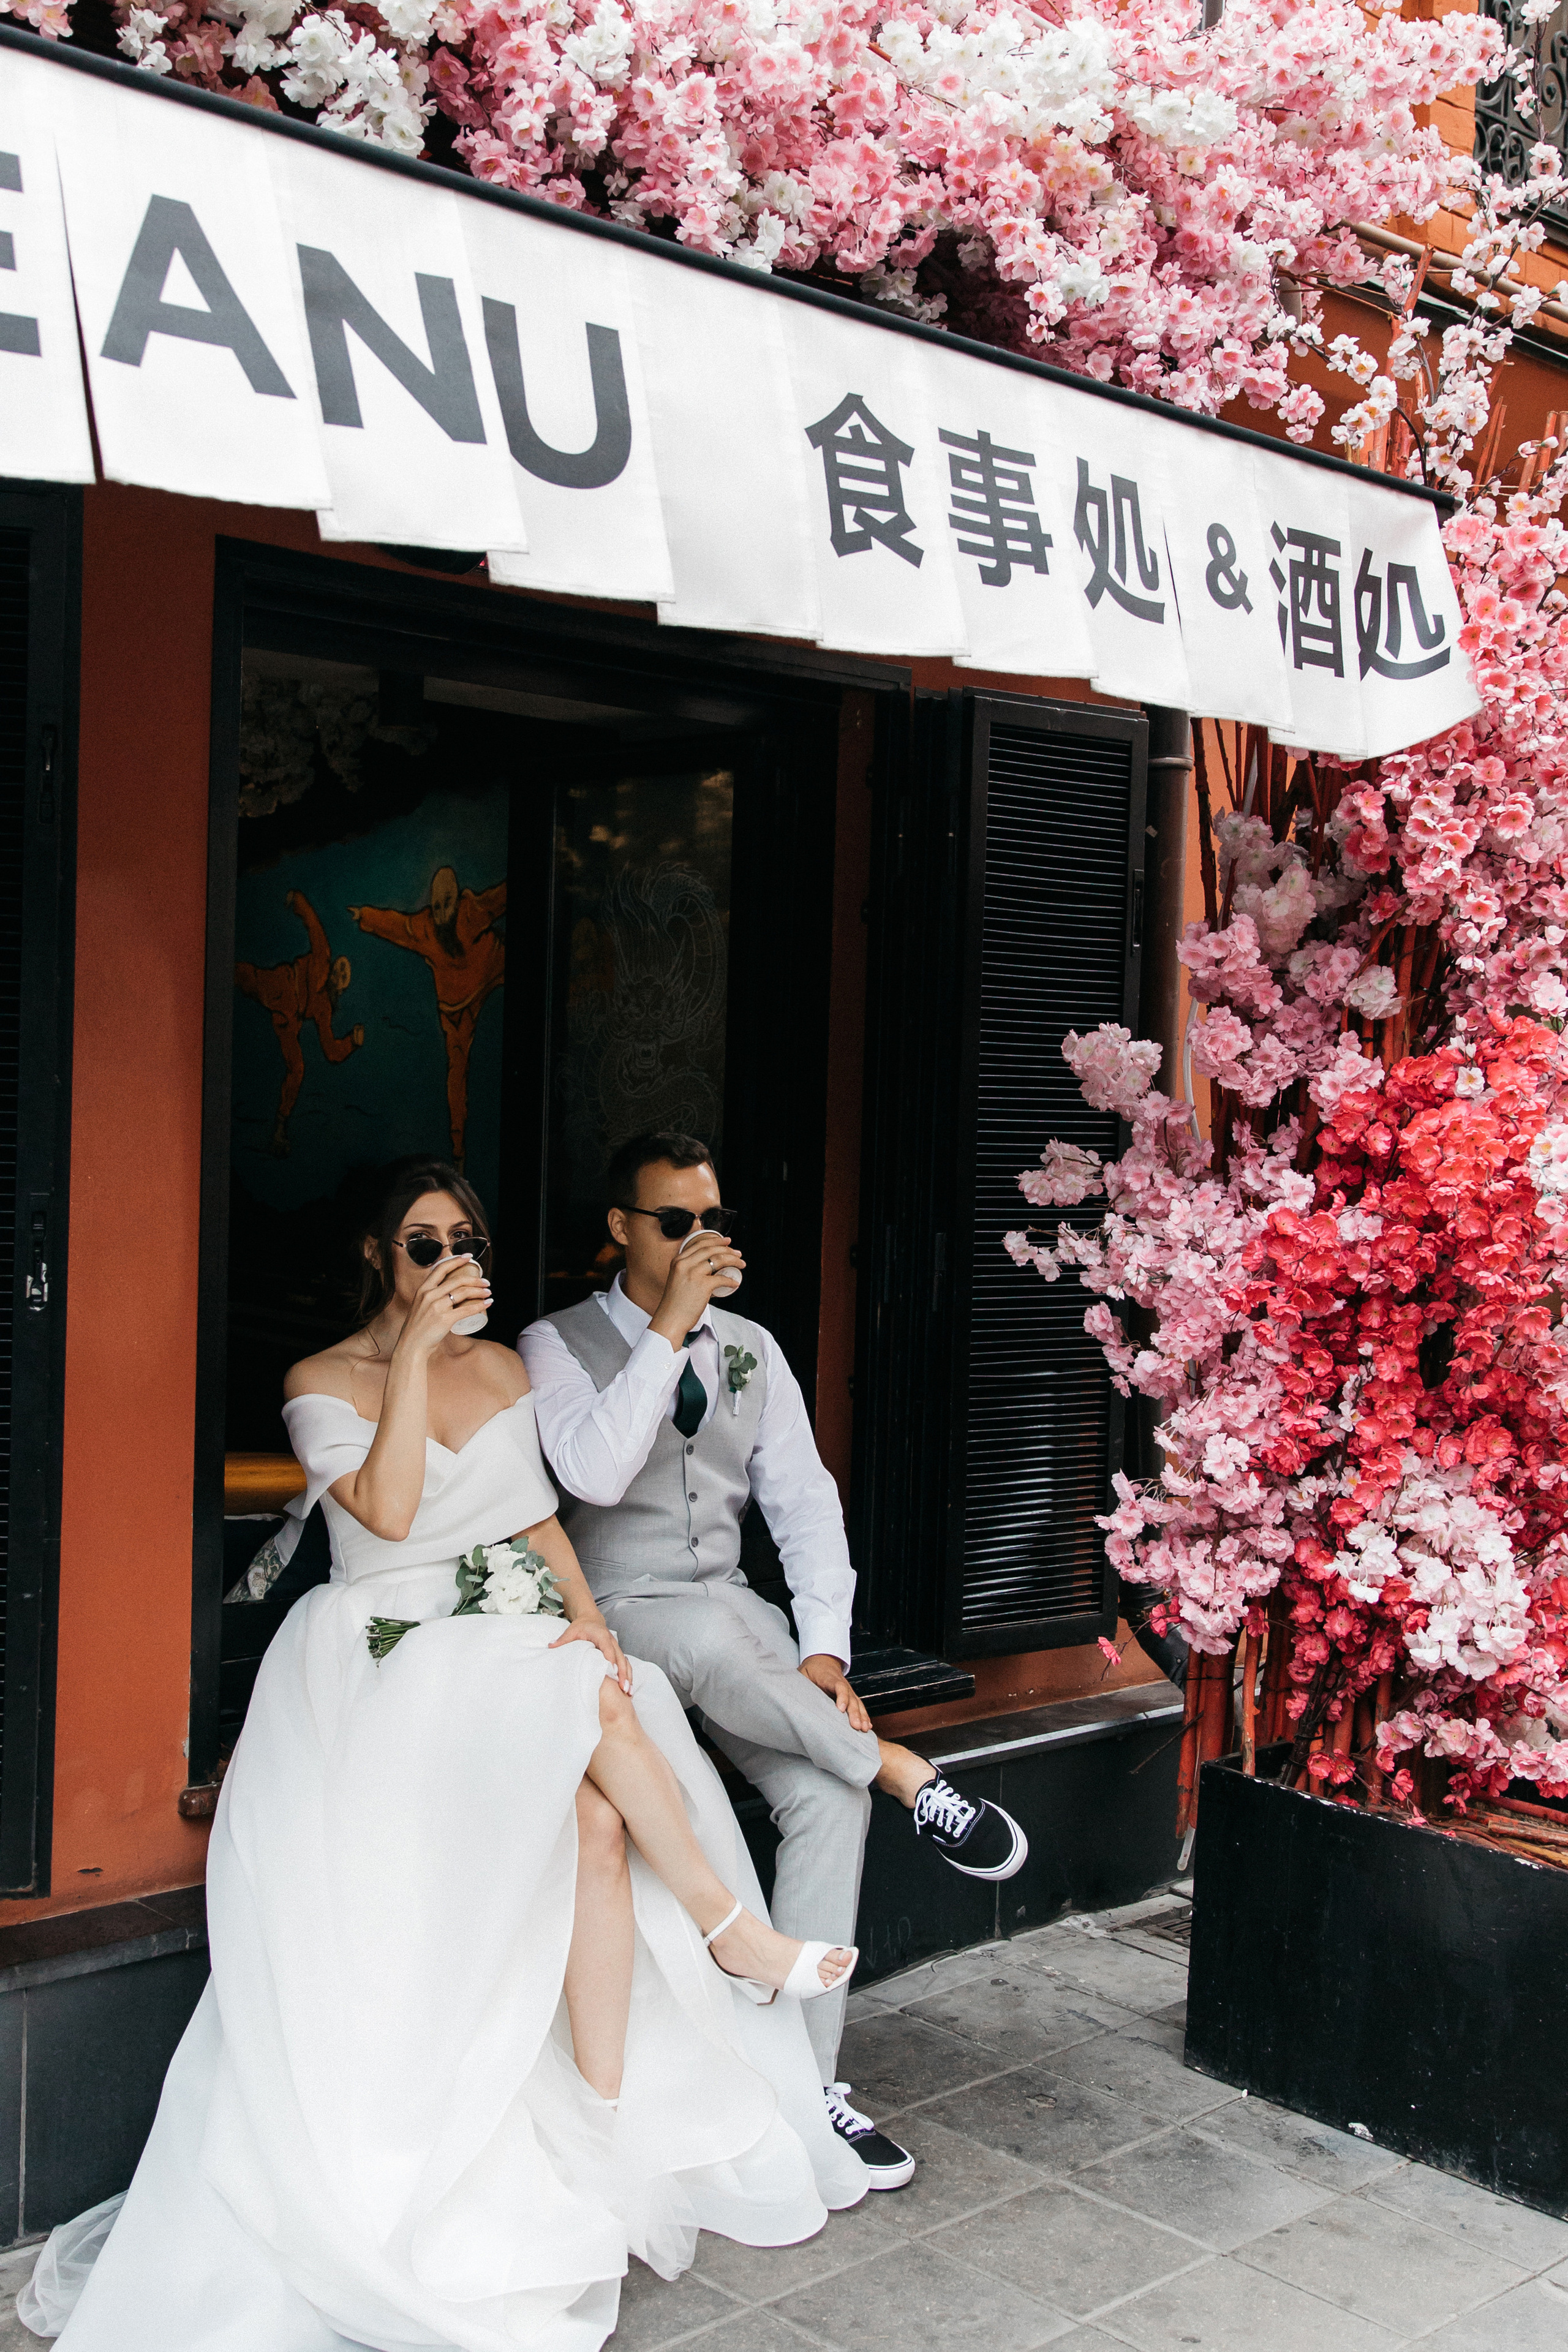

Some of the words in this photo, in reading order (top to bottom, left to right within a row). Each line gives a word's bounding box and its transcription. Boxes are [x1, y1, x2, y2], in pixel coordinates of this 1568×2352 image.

[804, 392, 1165, 625] 食事処
[1205, 522, 1254, 615] &
[1268, 520, 1451, 682] 酒処
